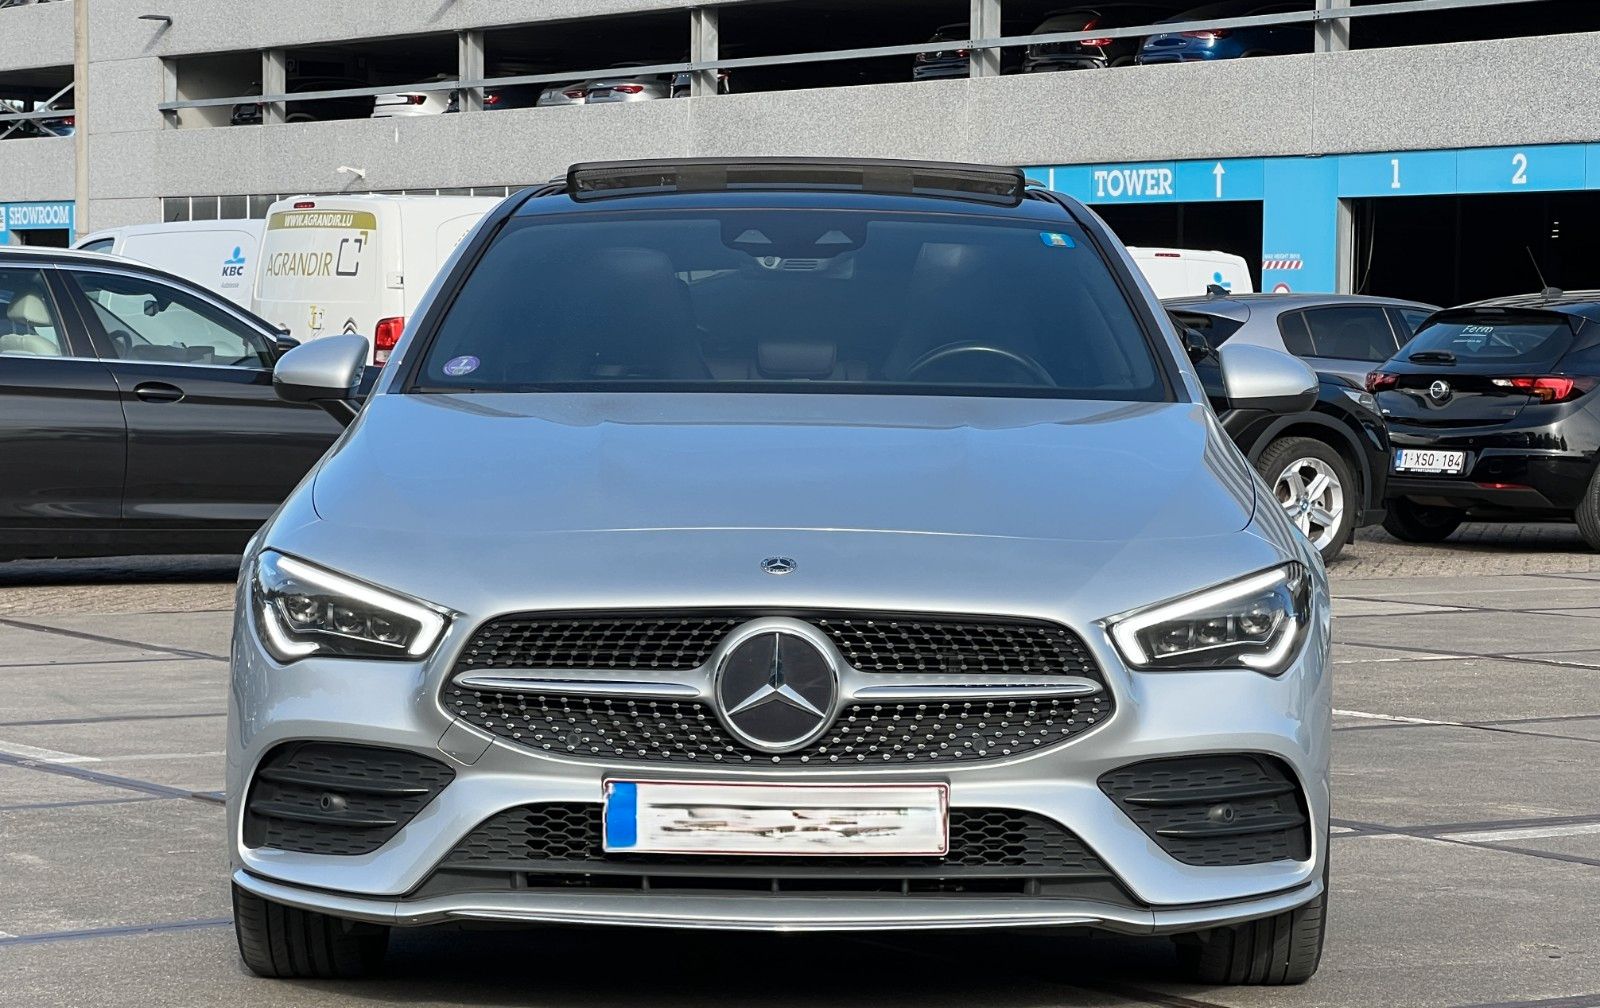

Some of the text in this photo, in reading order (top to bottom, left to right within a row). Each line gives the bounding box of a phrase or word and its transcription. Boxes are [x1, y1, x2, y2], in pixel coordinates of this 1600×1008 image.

[1391, 158, 1401, 189] 1
[1511, 153, 1528, 185] 2
[1094, 168, 1173, 197] TOWER
[9, 205, 70, 225] SHOWROOM
[284, 213, 354, 227] WWW.AGRANDIR.LU
[221, 266, 244, 277] KBC
[265, 252, 333, 277] AGRANDIR
